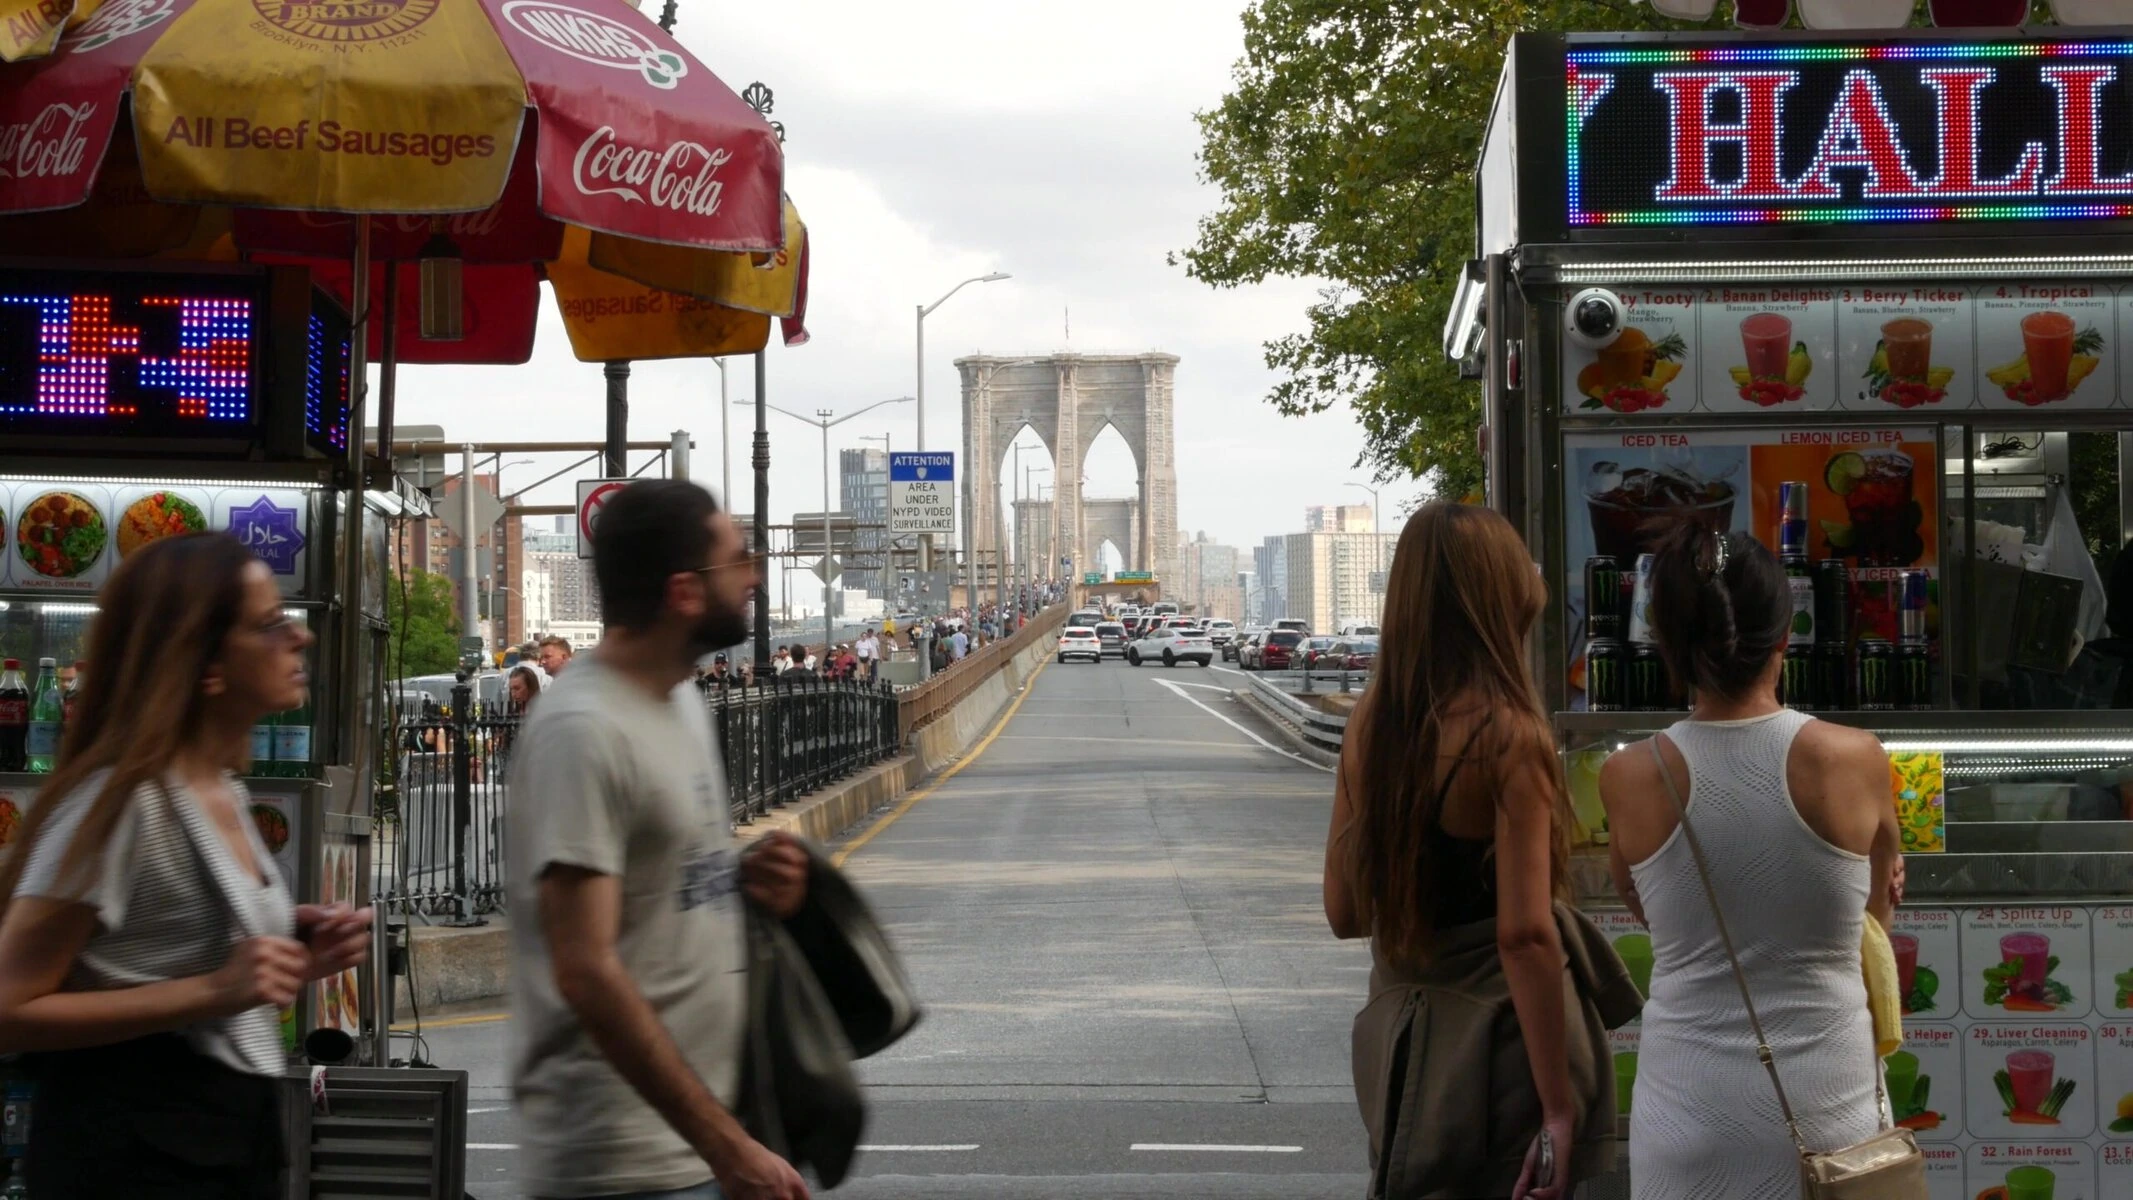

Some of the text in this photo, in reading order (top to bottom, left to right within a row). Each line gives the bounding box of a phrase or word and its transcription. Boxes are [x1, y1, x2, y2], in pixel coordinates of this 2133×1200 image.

[290, 3, 398, 20] BRAND
[8, 8, 43, 48] All
[521, 10, 642, 58] NIKAS
[164, 115, 496, 166] All Beef Sausages
[572, 125, 734, 217] Coca-Cola
[1722, 288, 1767, 303] Banan
[1770, 288, 1832, 305] Delights
[1863, 288, 1907, 306] Berry
[1912, 288, 1965, 302] Ticker
[2018, 283, 2095, 301] Tropical
[1642, 291, 1694, 309] Tooty
[1626, 315, 1674, 324] Strawberry
[1621, 434, 1689, 447] ICED TEA
[1781, 430, 1904, 445] LEMON ICED TEA
[894, 456, 950, 466] ATTENTION
[908, 482, 936, 492] AREA
[905, 495, 939, 504] UNDER
[892, 506, 952, 517] NYPD VIDEO
[893, 519, 952, 529] SURVEILLANCE
[250, 547, 281, 559] ALAL
[1864, 568, 1899, 581] ICED
[1913, 911, 1949, 921] Boost
[2000, 906, 2046, 922] Splitz
[2050, 905, 2073, 922] Up
[1608, 1030, 1641, 1041] Powe
[1914, 1028, 1954, 1042] Helper
[1996, 1028, 2029, 1038] Liver
[2031, 1027, 2088, 1041] Cleaning
[2008, 1146, 2033, 1156] Rain
[2036, 1146, 2073, 1156] Forest
